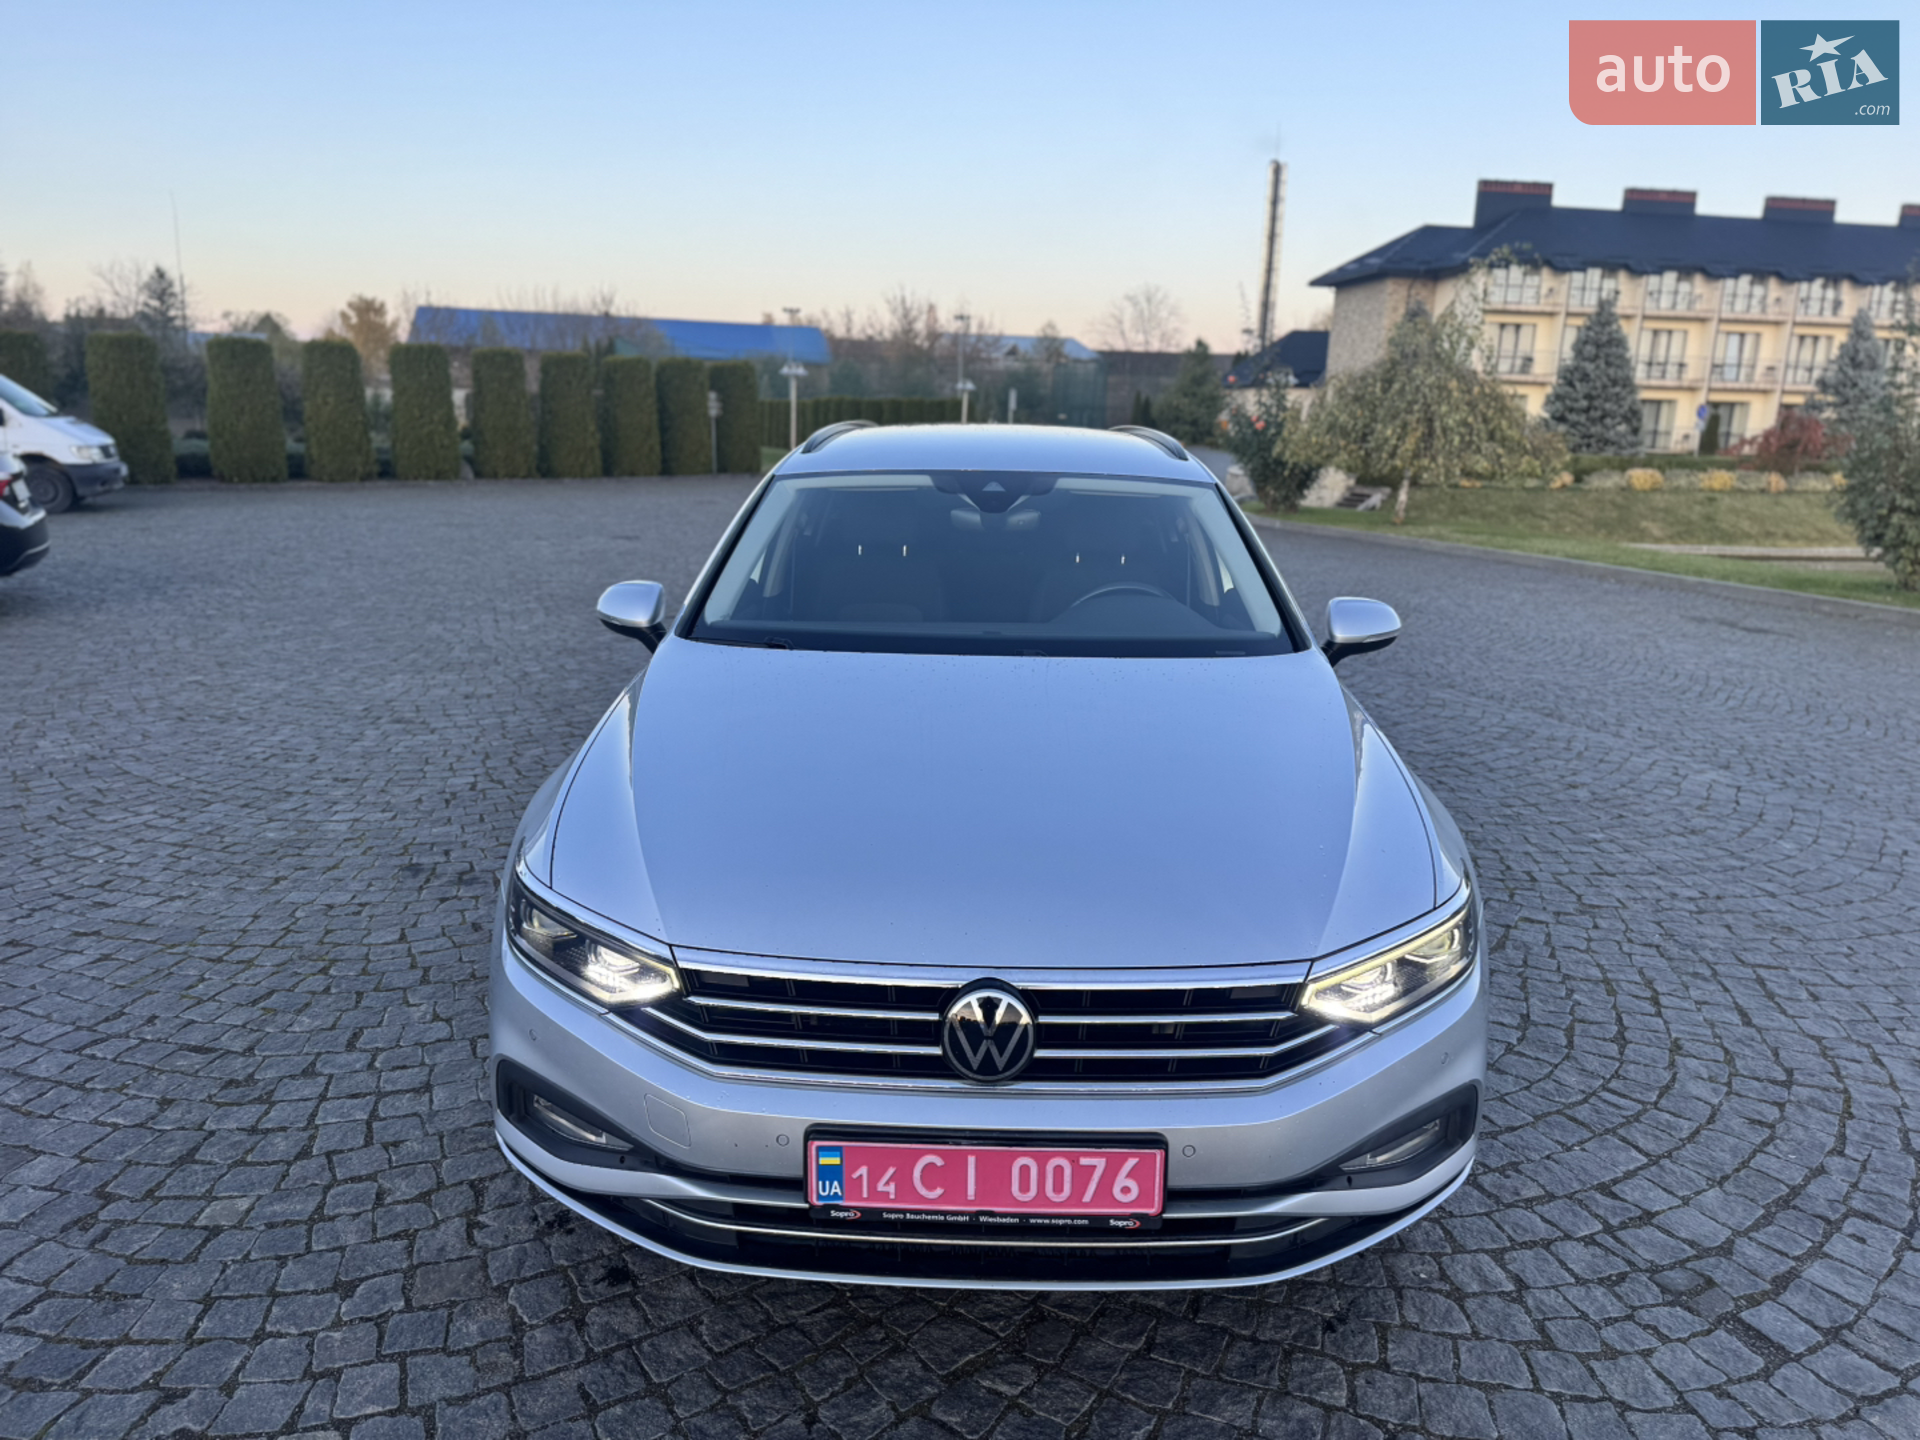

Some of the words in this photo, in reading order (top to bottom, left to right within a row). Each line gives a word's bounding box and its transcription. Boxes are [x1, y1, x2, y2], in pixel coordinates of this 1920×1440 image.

[851, 1165, 897, 1200] 14
[1011, 1156, 1140, 1204] 0076
[818, 1180, 842, 1197] UA
[830, 1210, 855, 1219] Sopro
[882, 1211, 904, 1220] Sopro
[946, 1214, 969, 1222] GmbH
[979, 1215, 1019, 1224] Wiesbaden
[1029, 1217, 1089, 1226] www.sopro.com
[1109, 1218, 1134, 1227] Sopro
